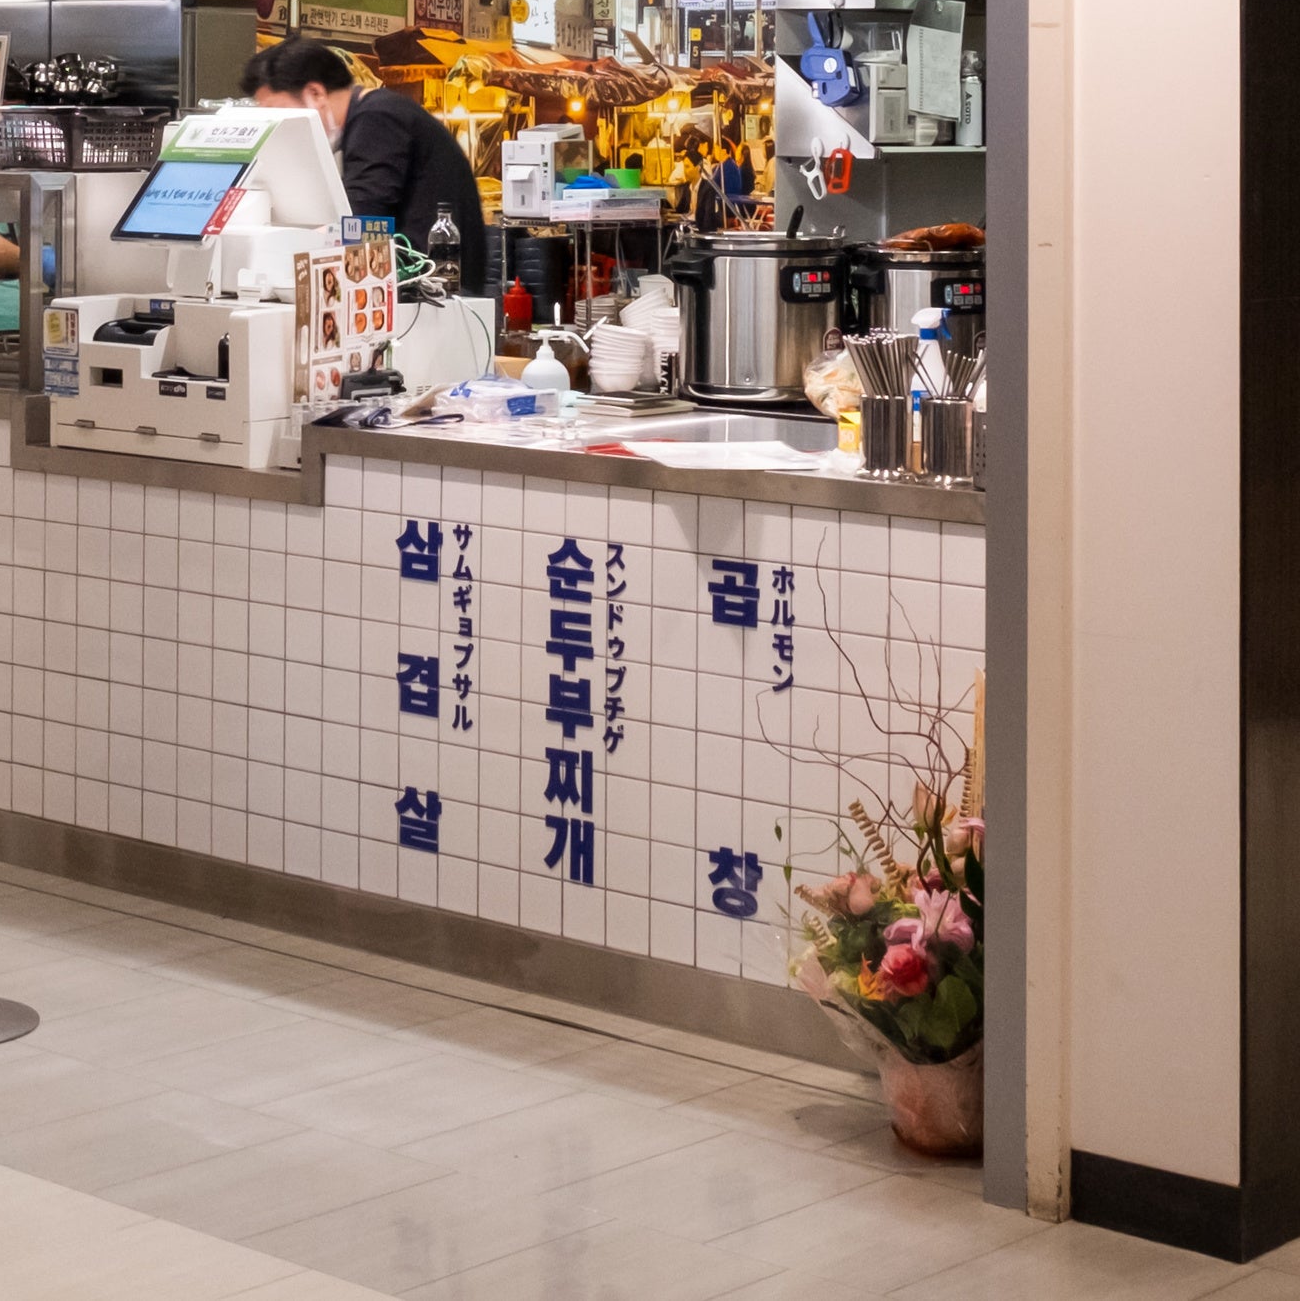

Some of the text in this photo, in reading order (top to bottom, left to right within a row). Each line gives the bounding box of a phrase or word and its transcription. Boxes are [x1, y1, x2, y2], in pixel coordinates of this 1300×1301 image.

[964, 99, 972, 125] SOTO
[394, 519, 443, 854] 삼겹살
[452, 524, 473, 731] サムギョプサル
[544, 538, 595, 885] 순두부찌개
[602, 543, 627, 753] スンドゥブチゲ
[770, 565, 796, 692] ホルモン
